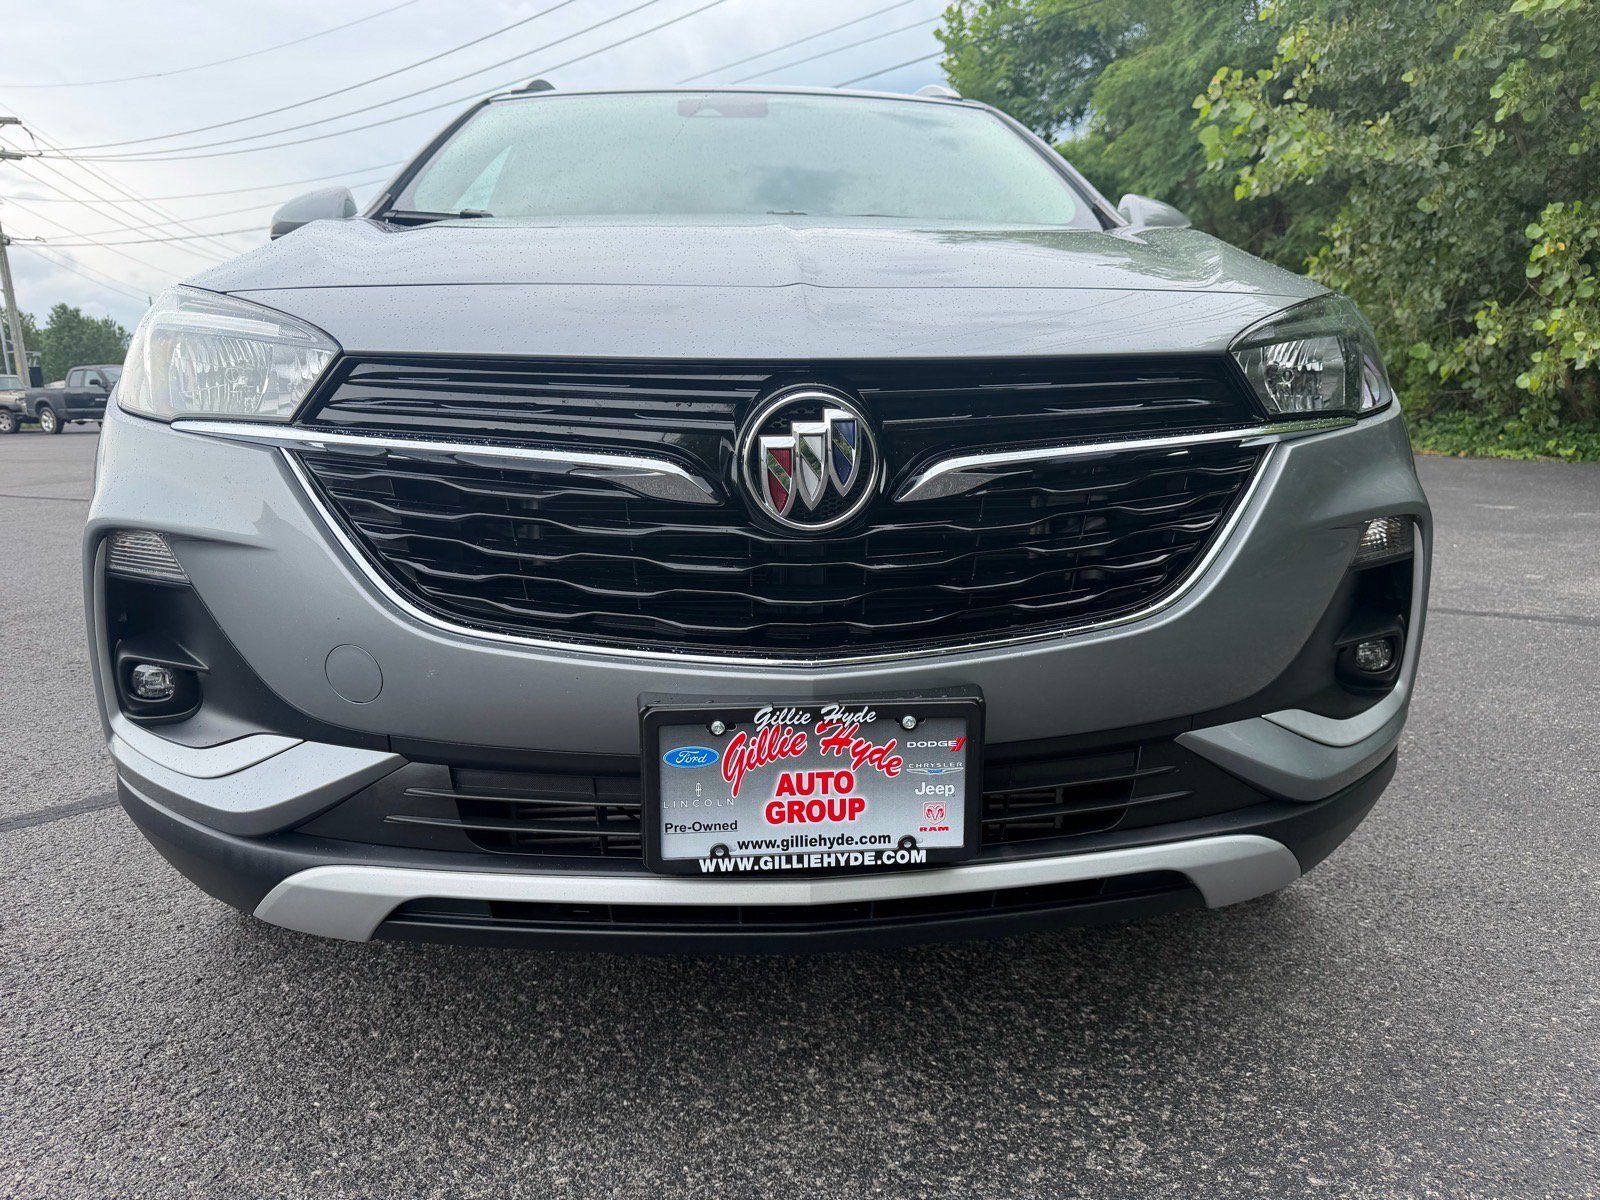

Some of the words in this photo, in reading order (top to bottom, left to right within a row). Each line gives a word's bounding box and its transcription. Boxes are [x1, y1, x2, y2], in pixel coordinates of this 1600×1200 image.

[754, 705, 812, 732] Gillie
[820, 704, 877, 728] Hyde
[907, 740, 957, 748] DODGE
[676, 751, 706, 764] Ford
[722, 723, 807, 798] Gillie
[816, 720, 903, 778] Hyde
[775, 771, 854, 796] AUTO
[915, 782, 955, 797] Jeep
[663, 799, 734, 808] LINCOLN
[765, 797, 865, 824] GROUP
[664, 820, 738, 833] Pre-Owned
[737, 833, 891, 851] www.gilliehyde.com
[699, 849, 927, 872] WWW.GILLIEHYDE.COM
